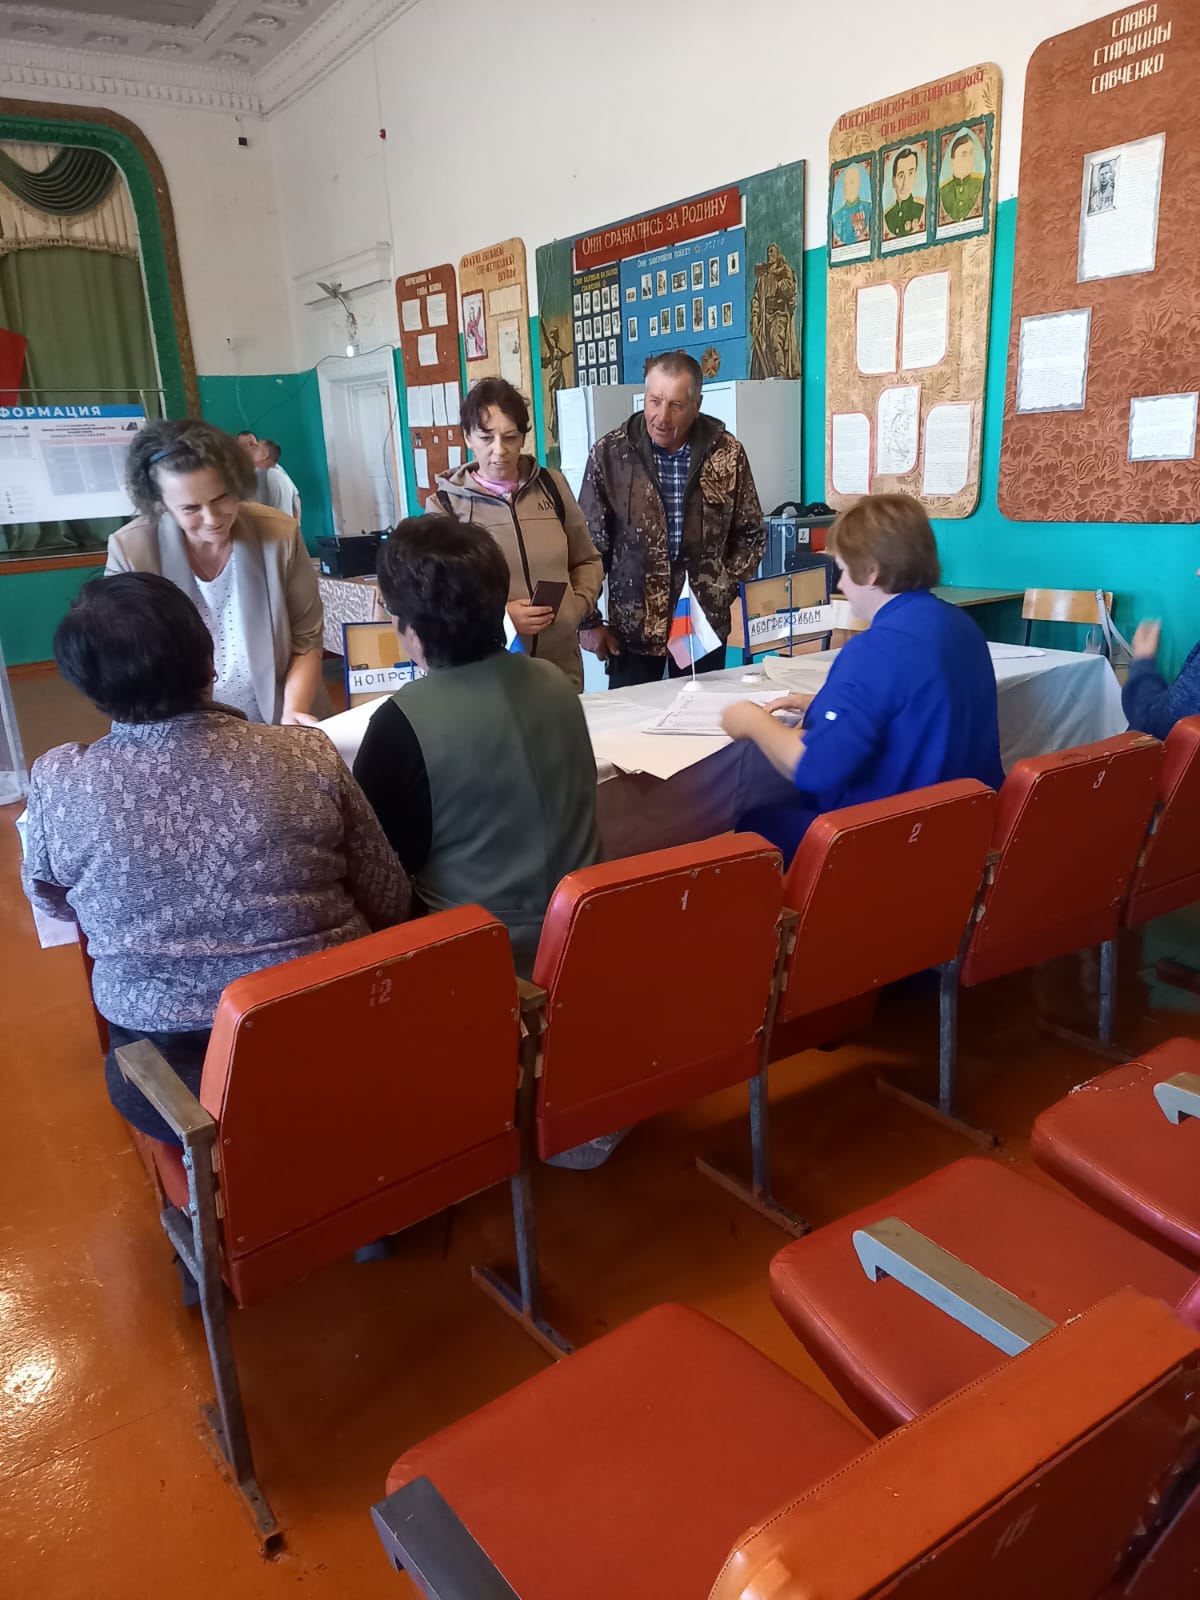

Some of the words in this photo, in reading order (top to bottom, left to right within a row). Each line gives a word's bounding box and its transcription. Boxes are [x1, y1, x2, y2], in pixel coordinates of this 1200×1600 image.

[1111, 3, 1157, 38] СЛАВА
[1093, 21, 1172, 67] СТАРШИНЫ
[1091, 53, 1164, 95] САВЧЕНКО
[582, 236, 602, 255] ОНИ
[604, 218, 664, 248] СРАЖАЛИСЬ
[666, 213, 680, 231] ЗА
[681, 195, 728, 226] РОДИНУ
[0, 406, 101, 418] ФОРМАЦИЯ
[908, 823, 922, 843] 2
